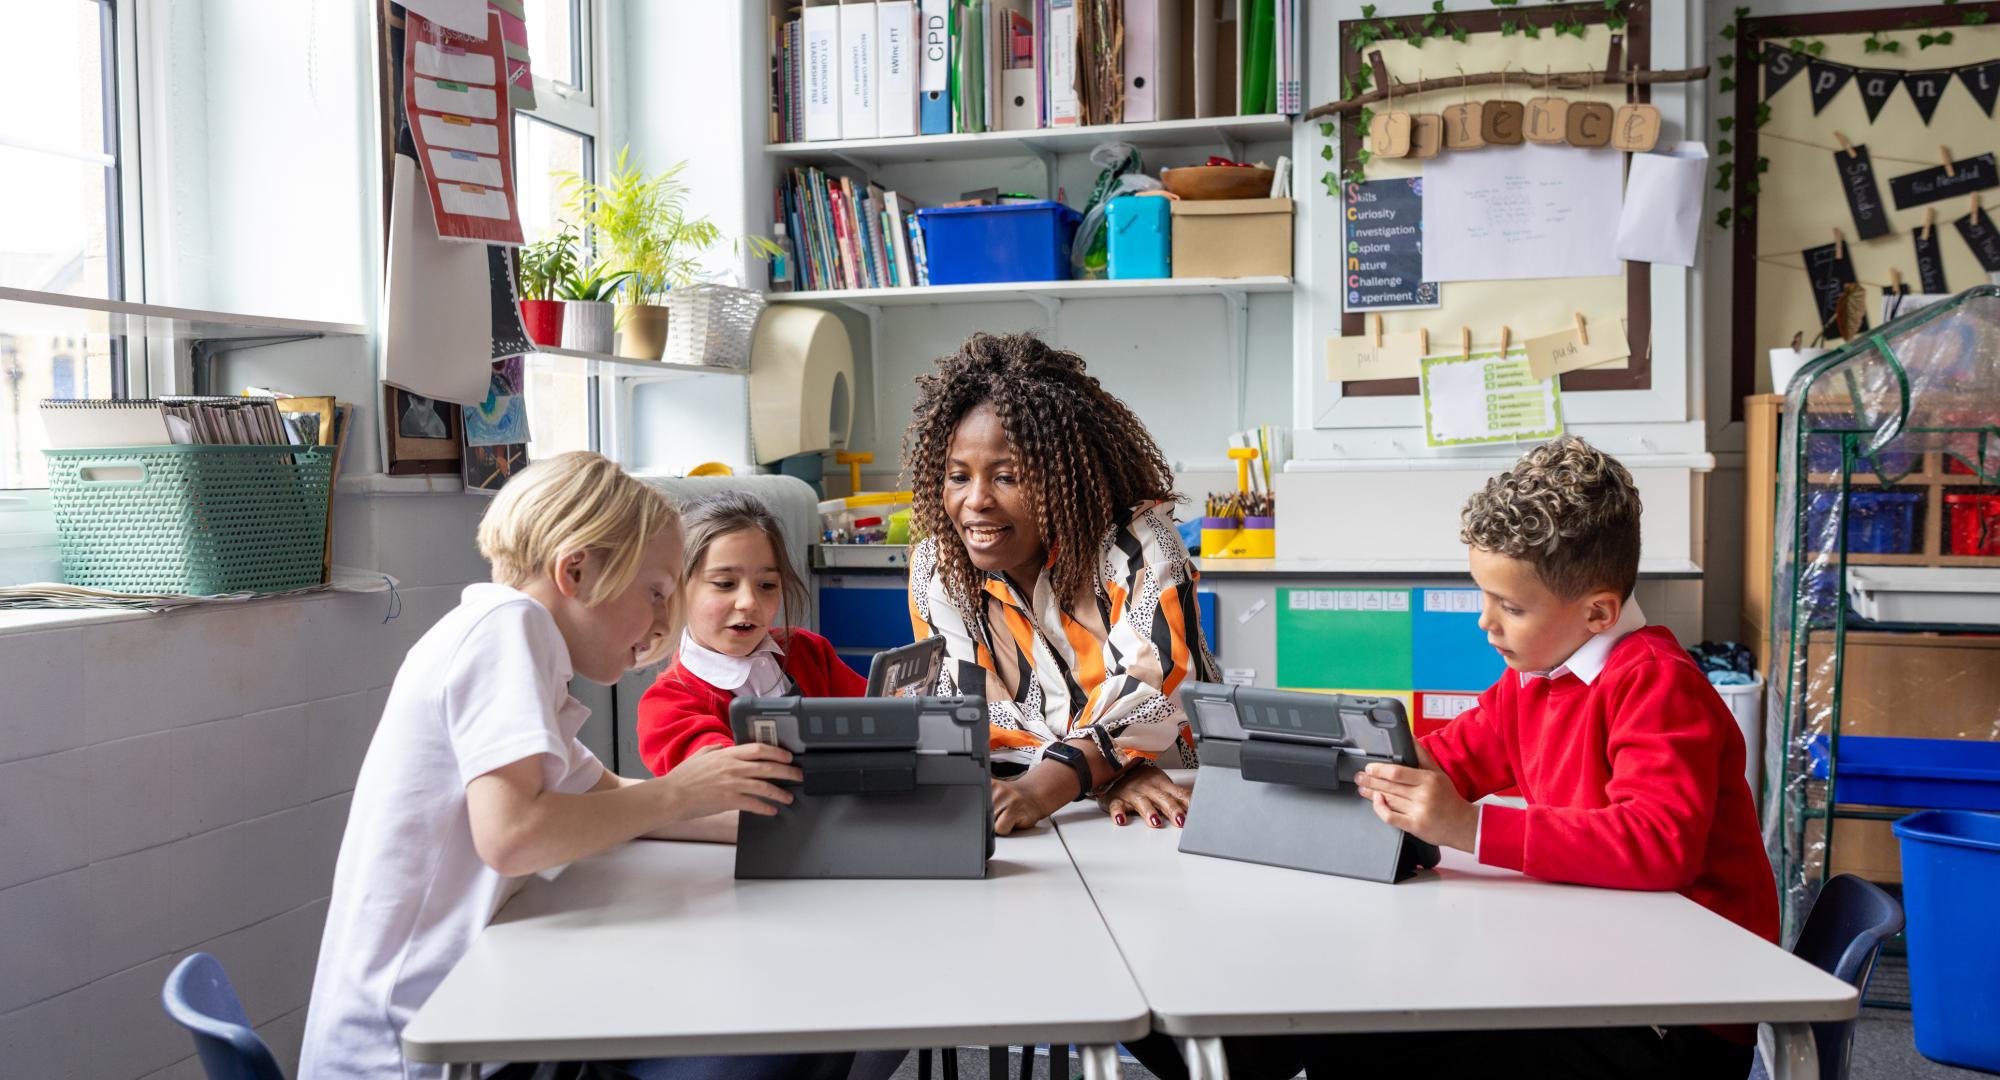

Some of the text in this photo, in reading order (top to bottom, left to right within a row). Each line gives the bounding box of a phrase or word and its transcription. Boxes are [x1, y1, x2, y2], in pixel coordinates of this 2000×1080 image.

[928, 15, 944, 62] CPD
[810, 42, 818, 87] LEADERSHIP
[821, 54, 829, 105] CURRICULUM
[1348, 183, 1377, 205] Skills
[1349, 222, 1415, 238] investigation
[1348, 241, 1391, 255] explore
[1348, 257, 1387, 271] nature
[1349, 290, 1413, 304] experiment
[1357, 348, 1380, 368] pull
[1552, 345, 1578, 365] push
